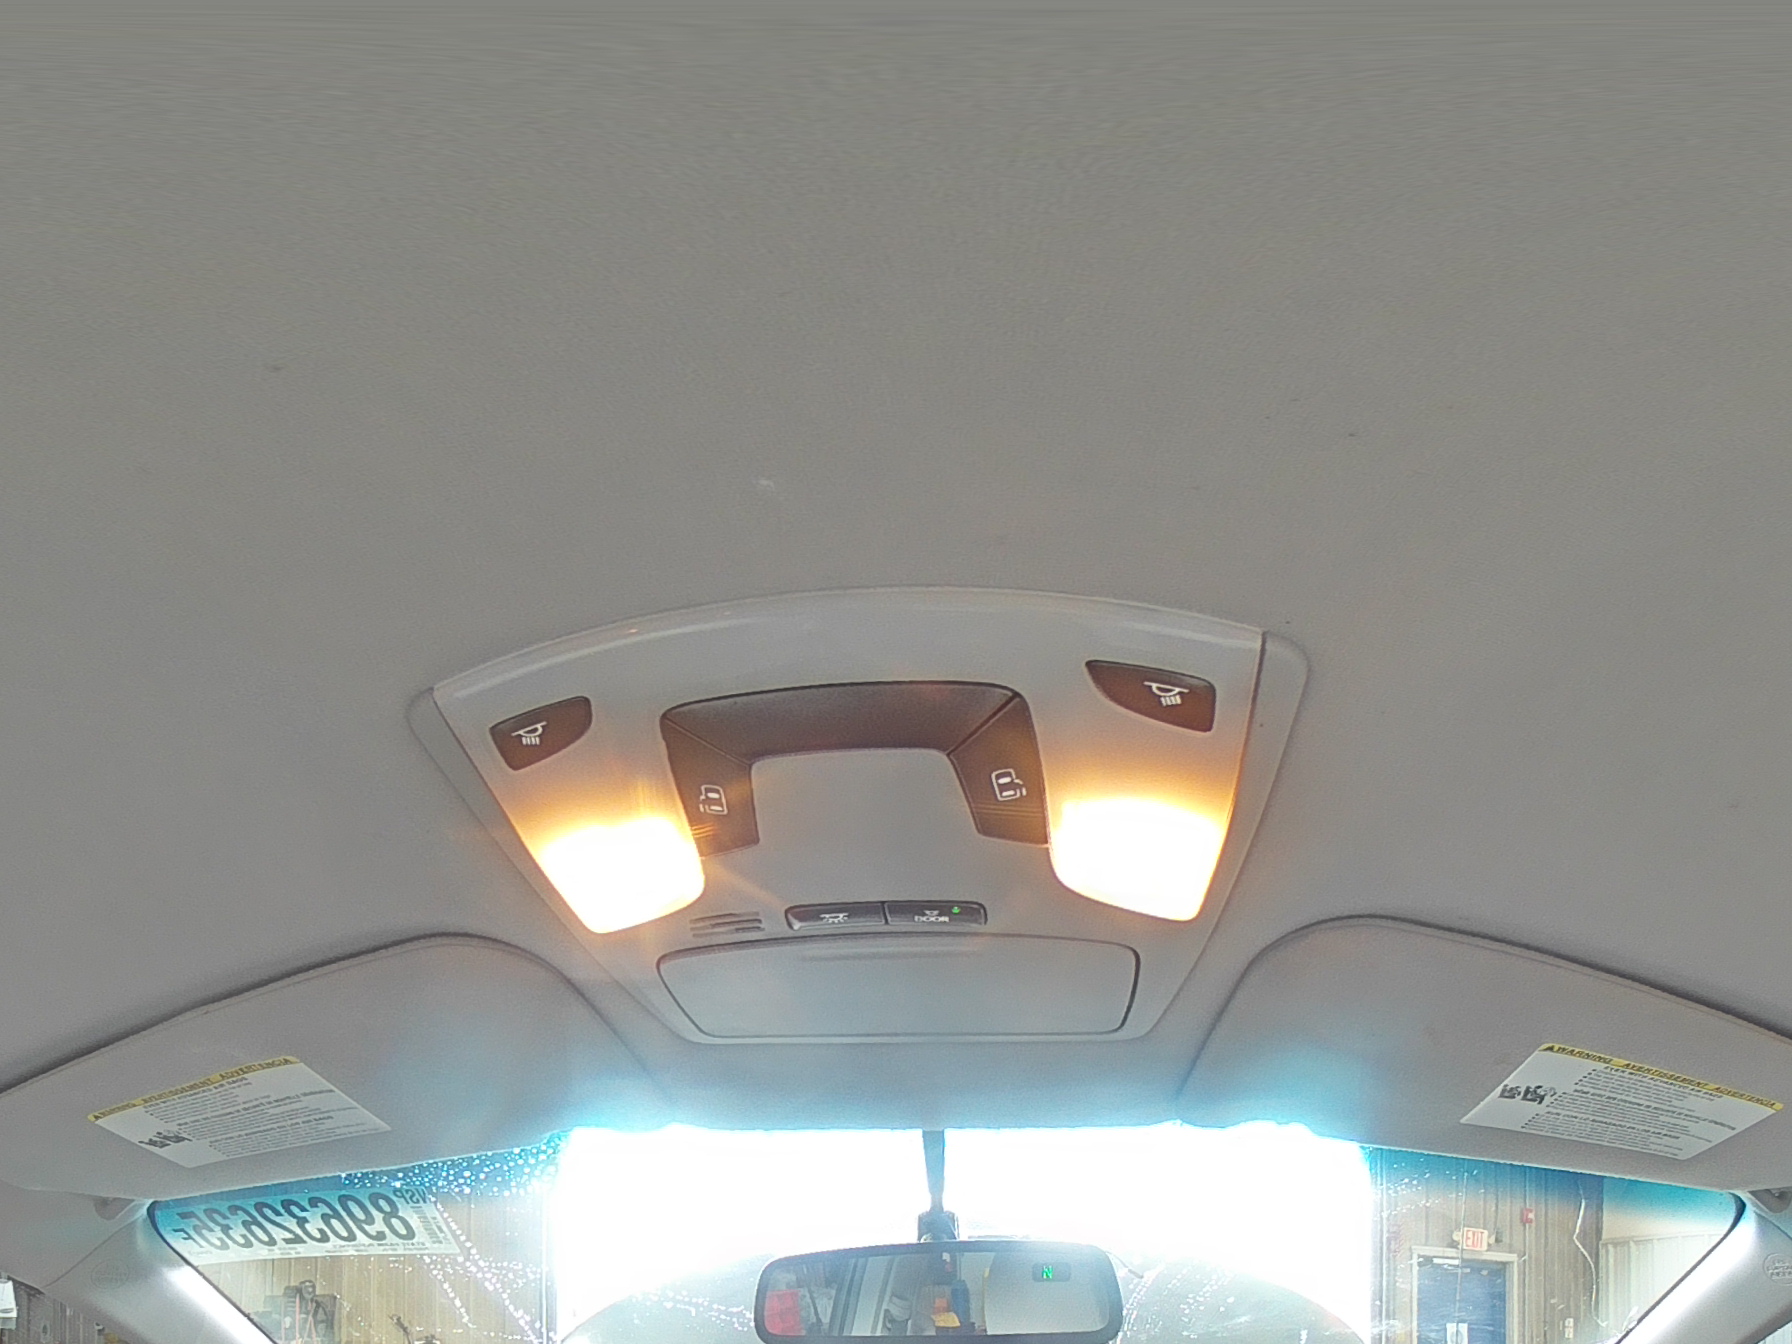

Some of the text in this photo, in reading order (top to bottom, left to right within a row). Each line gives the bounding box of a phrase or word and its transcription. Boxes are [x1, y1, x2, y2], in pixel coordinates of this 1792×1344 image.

[914, 914, 950, 923] DOOR
[219, 1057, 293, 1081] ADVERTENCIA
[1557, 1046, 1777, 1108] WARNING AVERTISSEMENT ADVERTENCIA
[1465, 1229, 1485, 1249] EXIT
[1041, 1265, 1054, 1279] N
